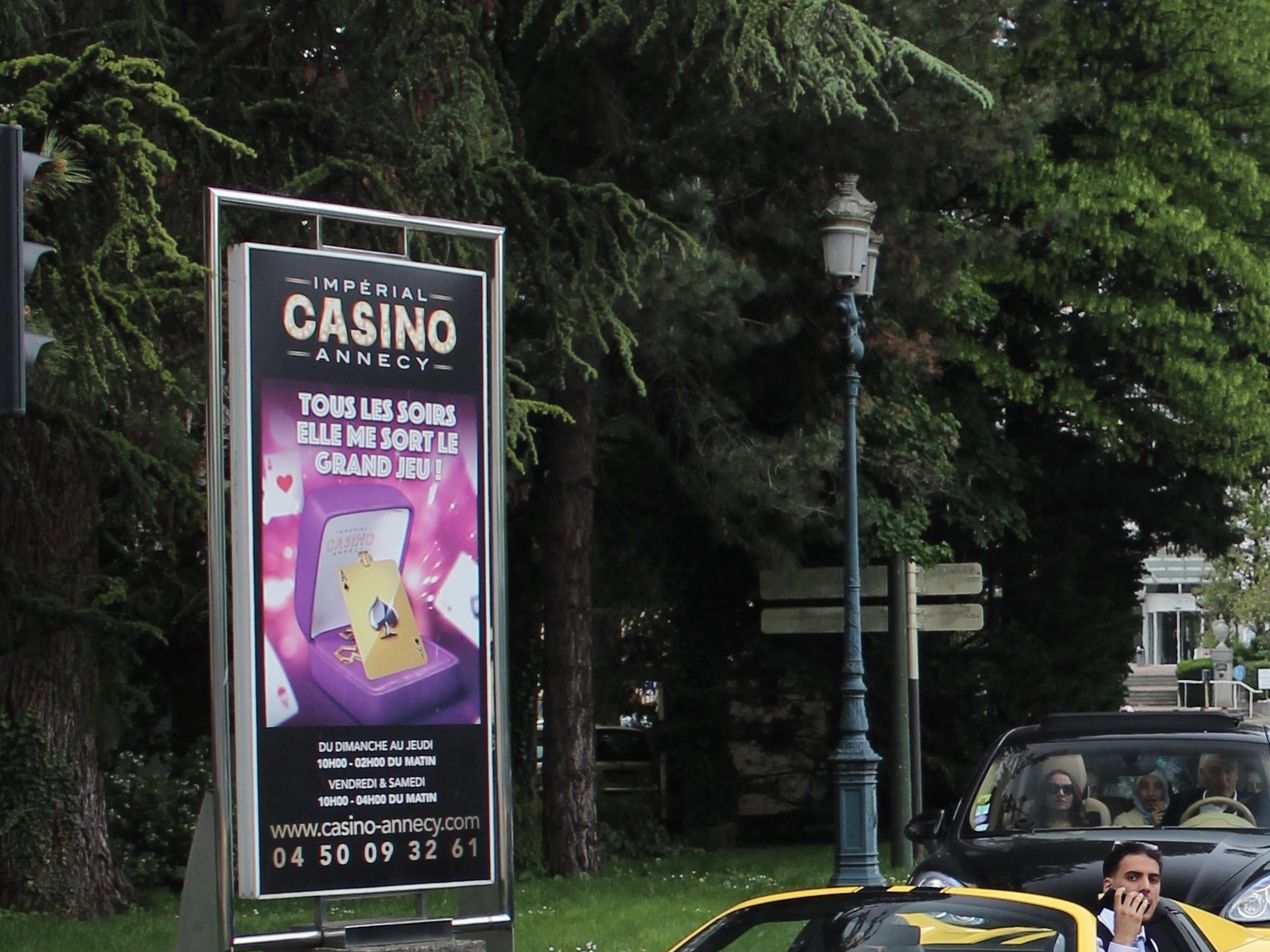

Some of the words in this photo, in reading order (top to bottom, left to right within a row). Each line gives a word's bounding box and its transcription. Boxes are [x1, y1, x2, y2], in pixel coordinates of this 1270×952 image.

[313, 276, 428, 302] IMPÉRIAL
[283, 293, 457, 354] CASINO
[315, 347, 430, 371] ANNECY
[298, 392, 357, 420] TOUS
[360, 397, 394, 423] LES
[396, 400, 457, 427] SOIRS
[297, 420, 342, 447] ELLE
[346, 424, 376, 449] ME
[380, 426, 434, 453] SORT
[438, 431, 459, 455] LE
[315, 451, 392, 478] GRAND
[395, 456, 431, 480] JEU
[326, 532, 376, 553] CASINO
[318, 741, 334, 753] DU
[335, 740, 388, 752] DIMANCHE
[390, 740, 404, 751] AU
[405, 739, 434, 751] JEUDI
[316, 758, 348, 769] 10H00
[354, 757, 386, 768] 02H00
[387, 756, 402, 767] DU
[404, 755, 437, 767] MATIN
[328, 778, 377, 790] VENDREDI
[379, 777, 387, 788] &
[388, 776, 426, 788] SAMEDI
[318, 795, 349, 807] 10H00
[355, 794, 387, 805] 04H00
[388, 793, 403, 804] DU
[405, 792, 437, 804] MATIN
[270, 815, 480, 839] www.casino-annecy.com
[273, 845, 305, 869] 04
[319, 843, 350, 866] 50
[364, 841, 394, 864] 09
[408, 839, 437, 861] 32
[451, 837, 478, 859] 61
